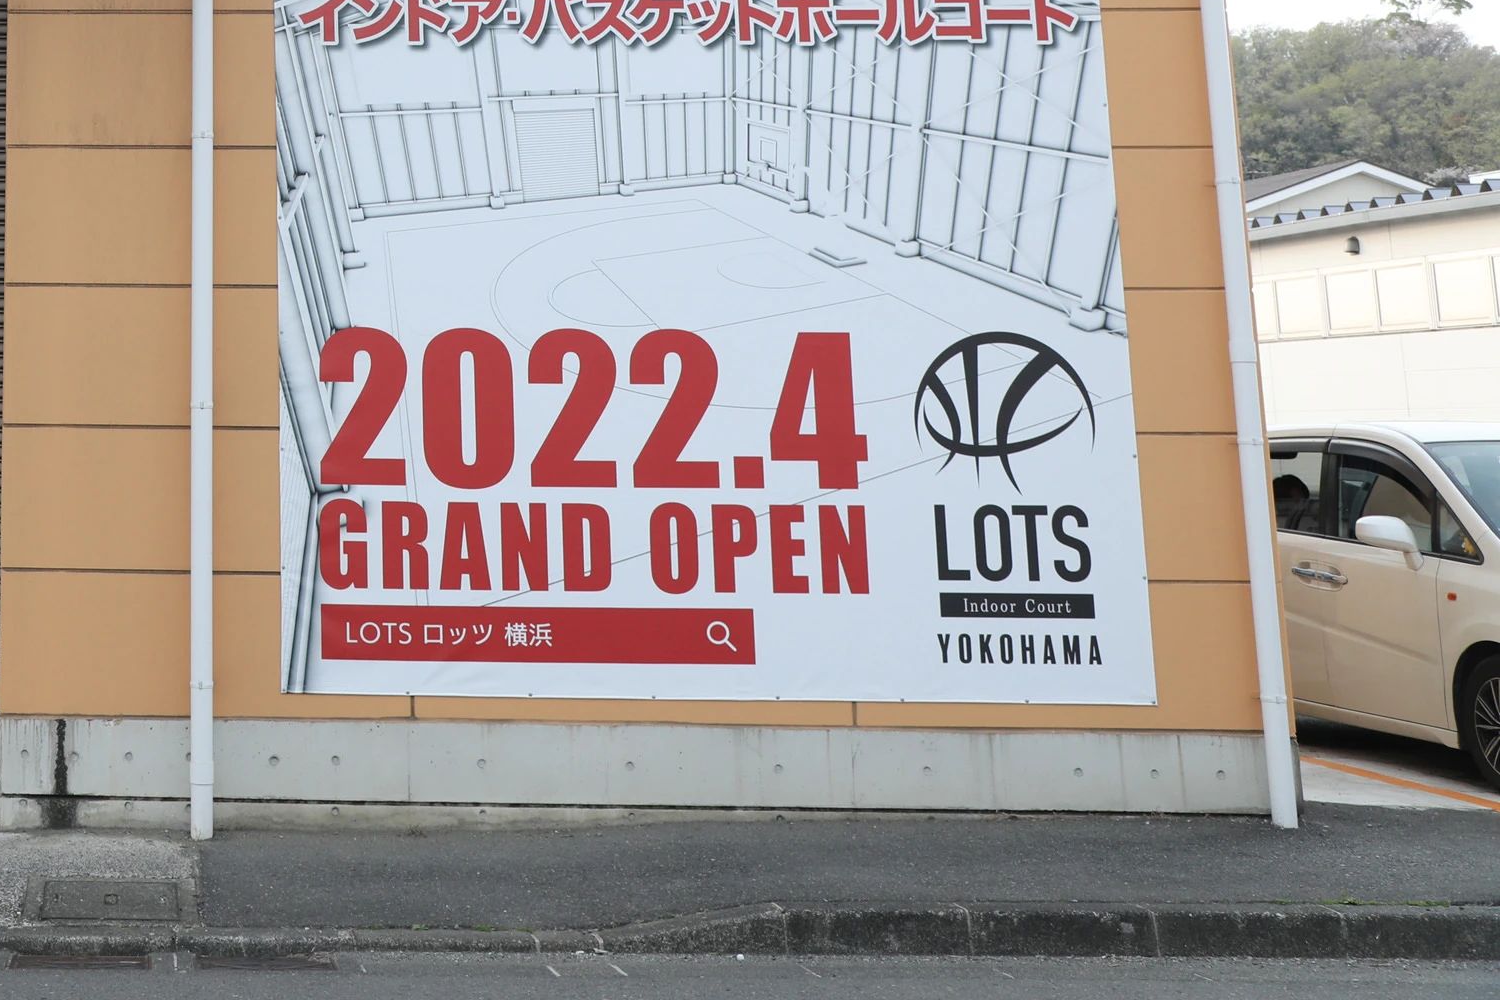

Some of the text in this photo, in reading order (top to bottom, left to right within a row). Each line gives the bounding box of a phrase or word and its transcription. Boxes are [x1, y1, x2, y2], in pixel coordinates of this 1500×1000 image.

[318, 326, 869, 490] 2022.4
[318, 499, 870, 595] GRAND OPEN
[933, 503, 1092, 583] LOTS
[963, 597, 1072, 614] Indoor Court
[345, 621, 553, 648] LOTS ロッツ 横浜
[936, 633, 1103, 665] YOKOHAMA
